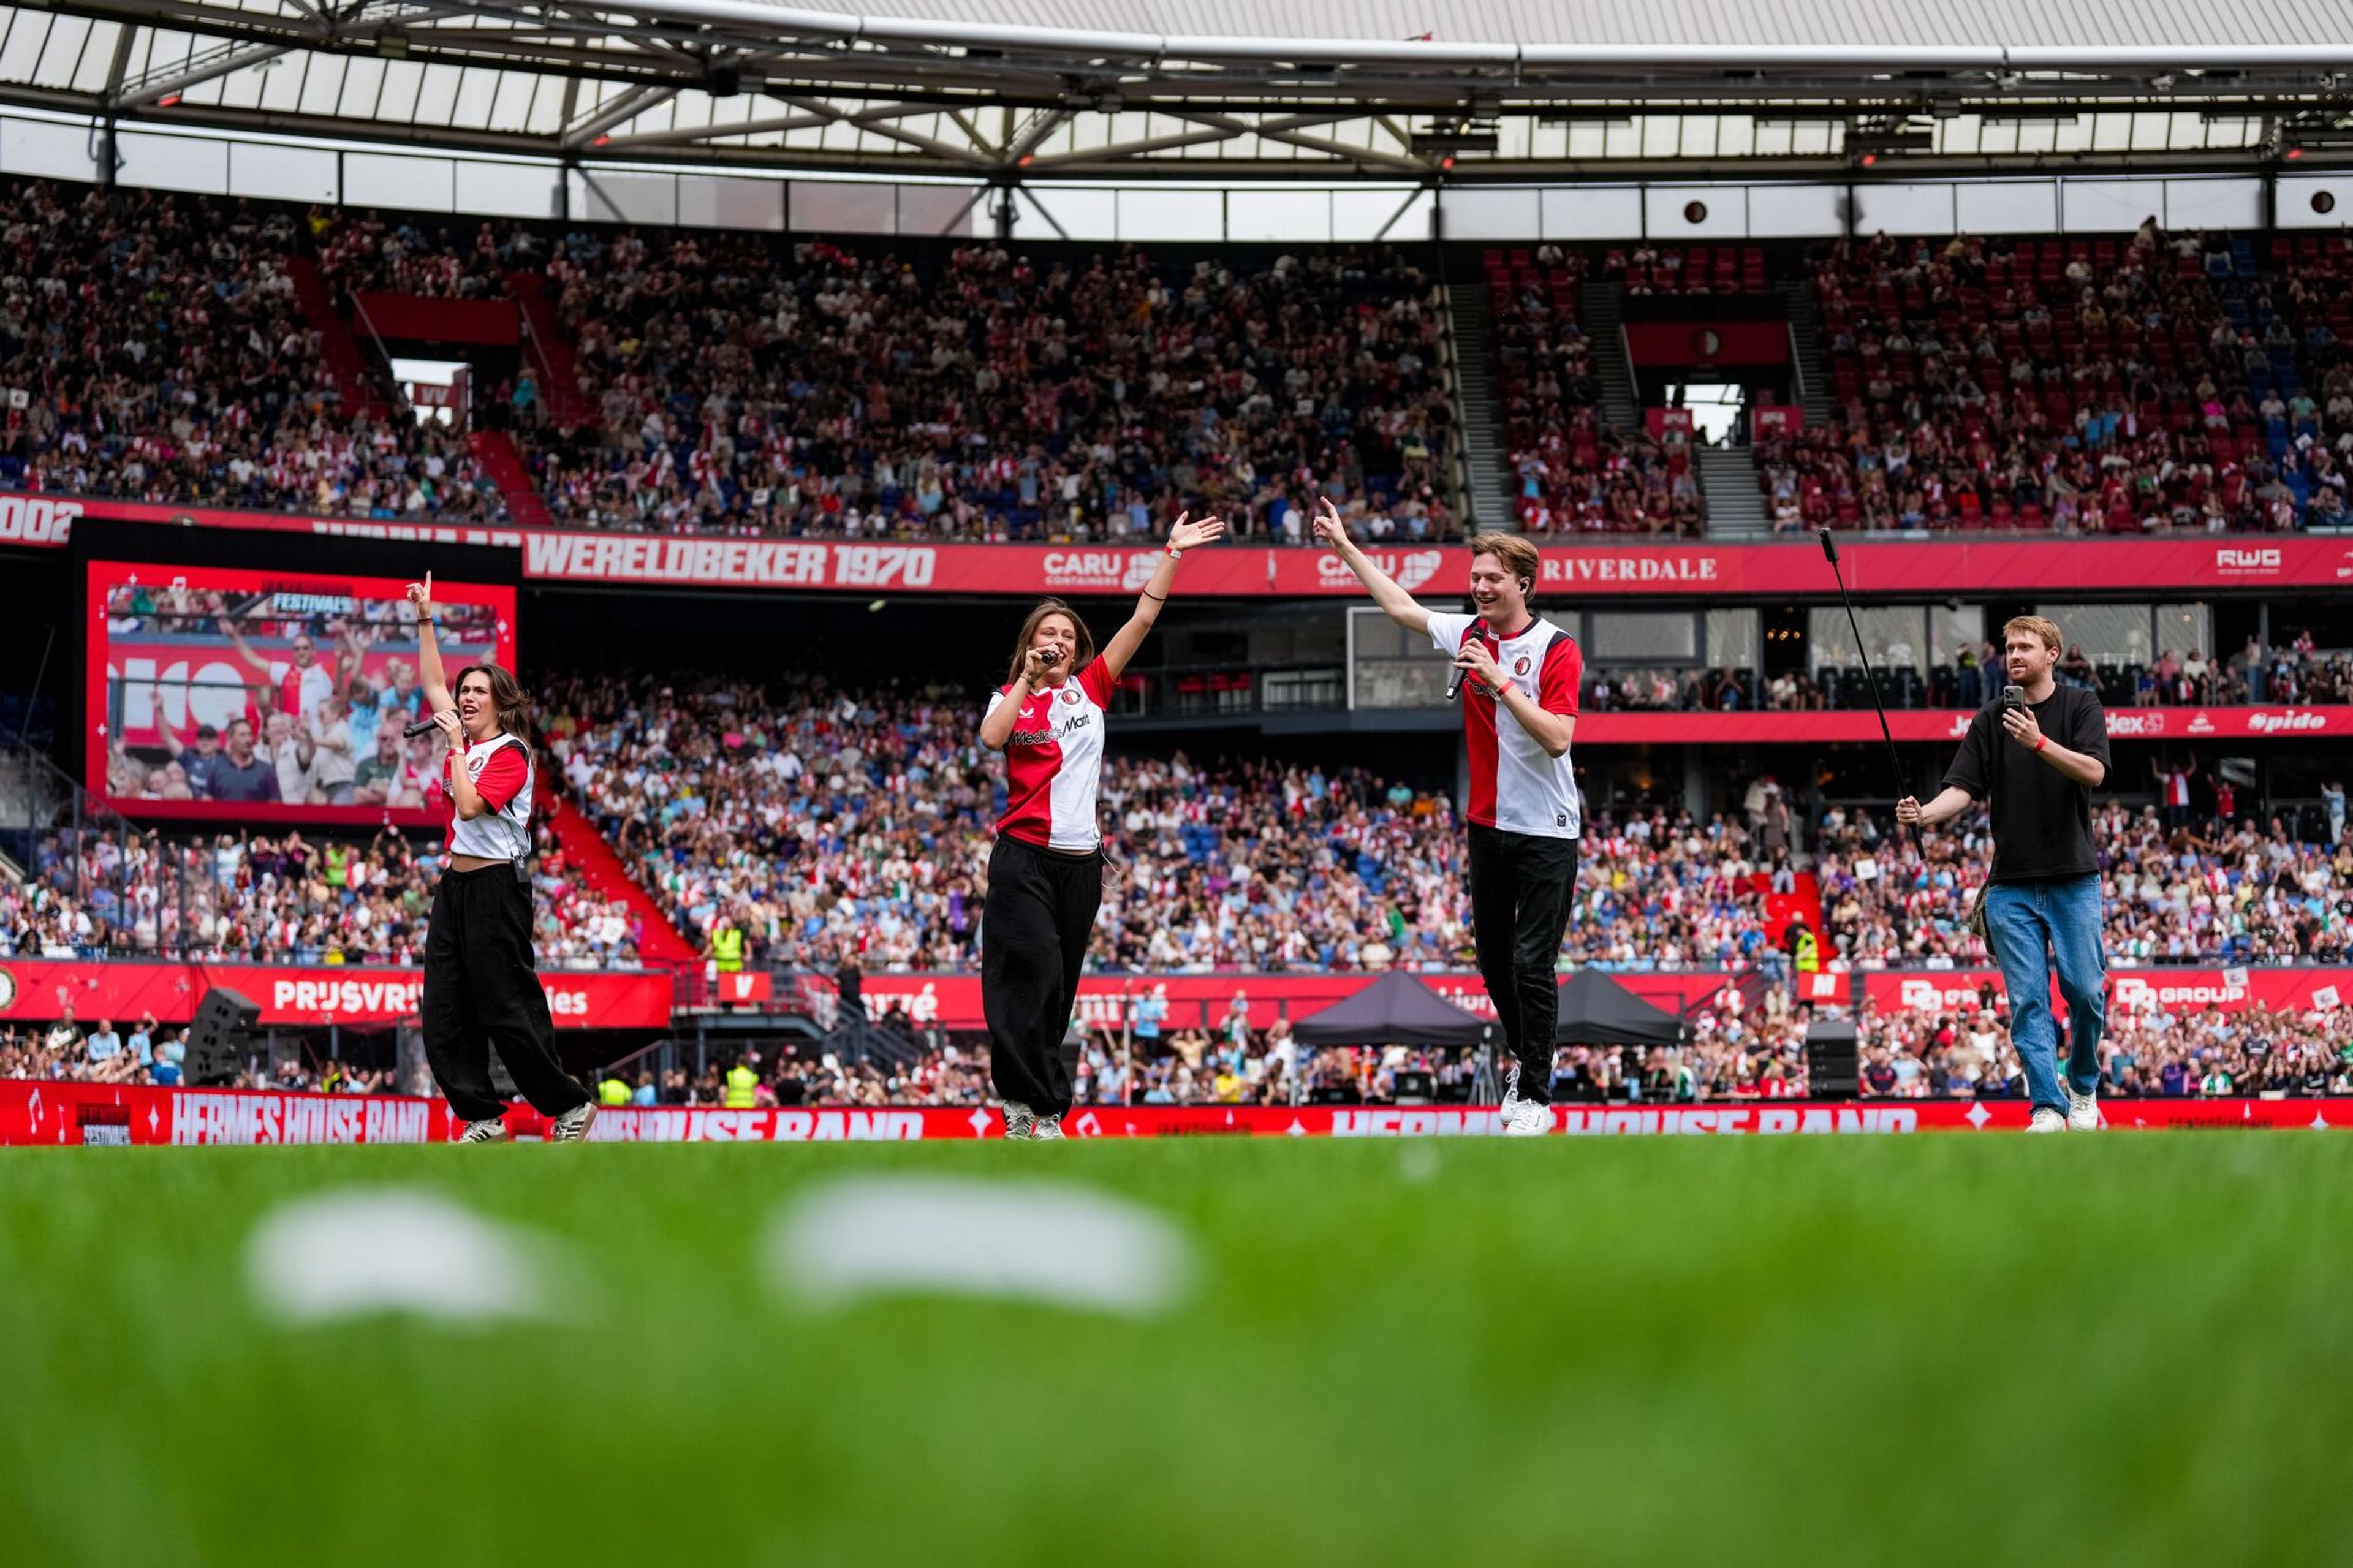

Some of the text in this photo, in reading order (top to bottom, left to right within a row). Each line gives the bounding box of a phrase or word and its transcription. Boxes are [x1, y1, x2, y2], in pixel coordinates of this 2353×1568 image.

[526, 534, 825, 583] WERELDBEKER
[834, 545, 936, 586] 1970
[1044, 553, 1121, 575] CARU
[1543, 558, 1718, 580] RIVERDALE
[2248, 709, 2327, 733] Spido
[2159, 987, 2245, 1003] GROUP
[365, 1100, 428, 1143] BAND
